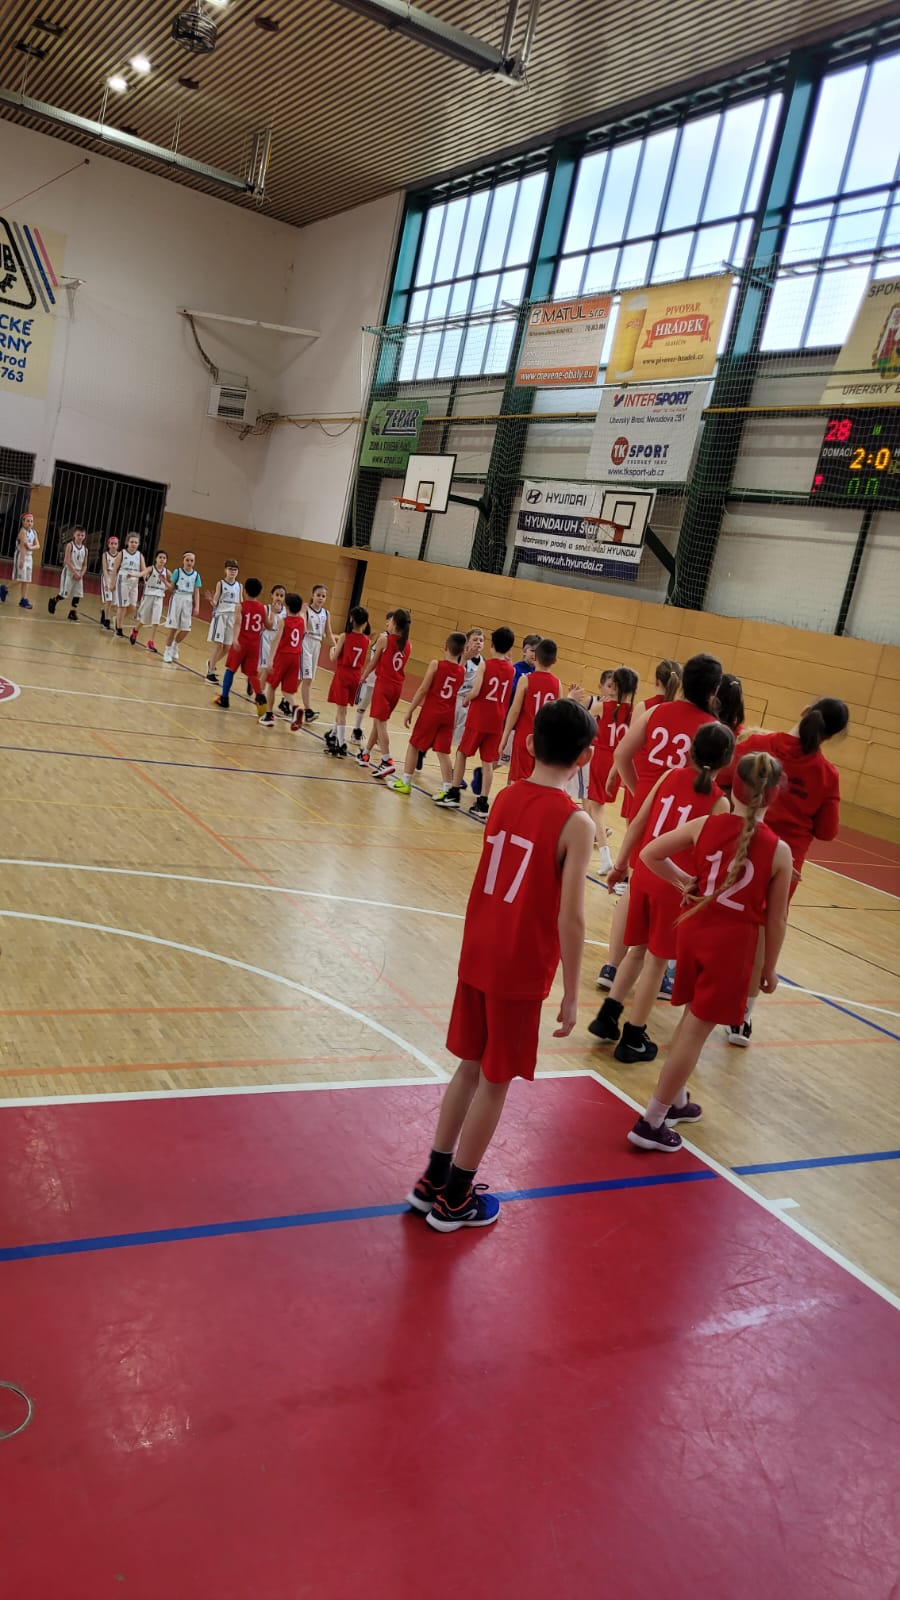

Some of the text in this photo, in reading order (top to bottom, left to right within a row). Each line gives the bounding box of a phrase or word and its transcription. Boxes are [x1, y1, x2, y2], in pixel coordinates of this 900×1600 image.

[543, 306, 586, 323] MATUL
[665, 303, 701, 315] PIVOVAR
[655, 319, 704, 337] HRÁDEK
[624, 391, 694, 407] INTERSPORT
[824, 419, 852, 441] 28
[614, 444, 670, 458] TK SPORT
[849, 447, 890, 470] 2:0
[546, 492, 587, 507] HYUNDAI
[607, 547, 637, 558] HYUNDAI
[244, 613, 262, 632] 13
[290, 628, 300, 648] 9
[352, 646, 363, 667] 7
[392, 651, 403, 672] 6
[440, 676, 457, 699] 5
[485, 676, 510, 704] 21
[648, 727, 692, 770] 23
[652, 794, 693, 838] 11
[483, 830, 534, 904] 17
[704, 850, 755, 912] 12
